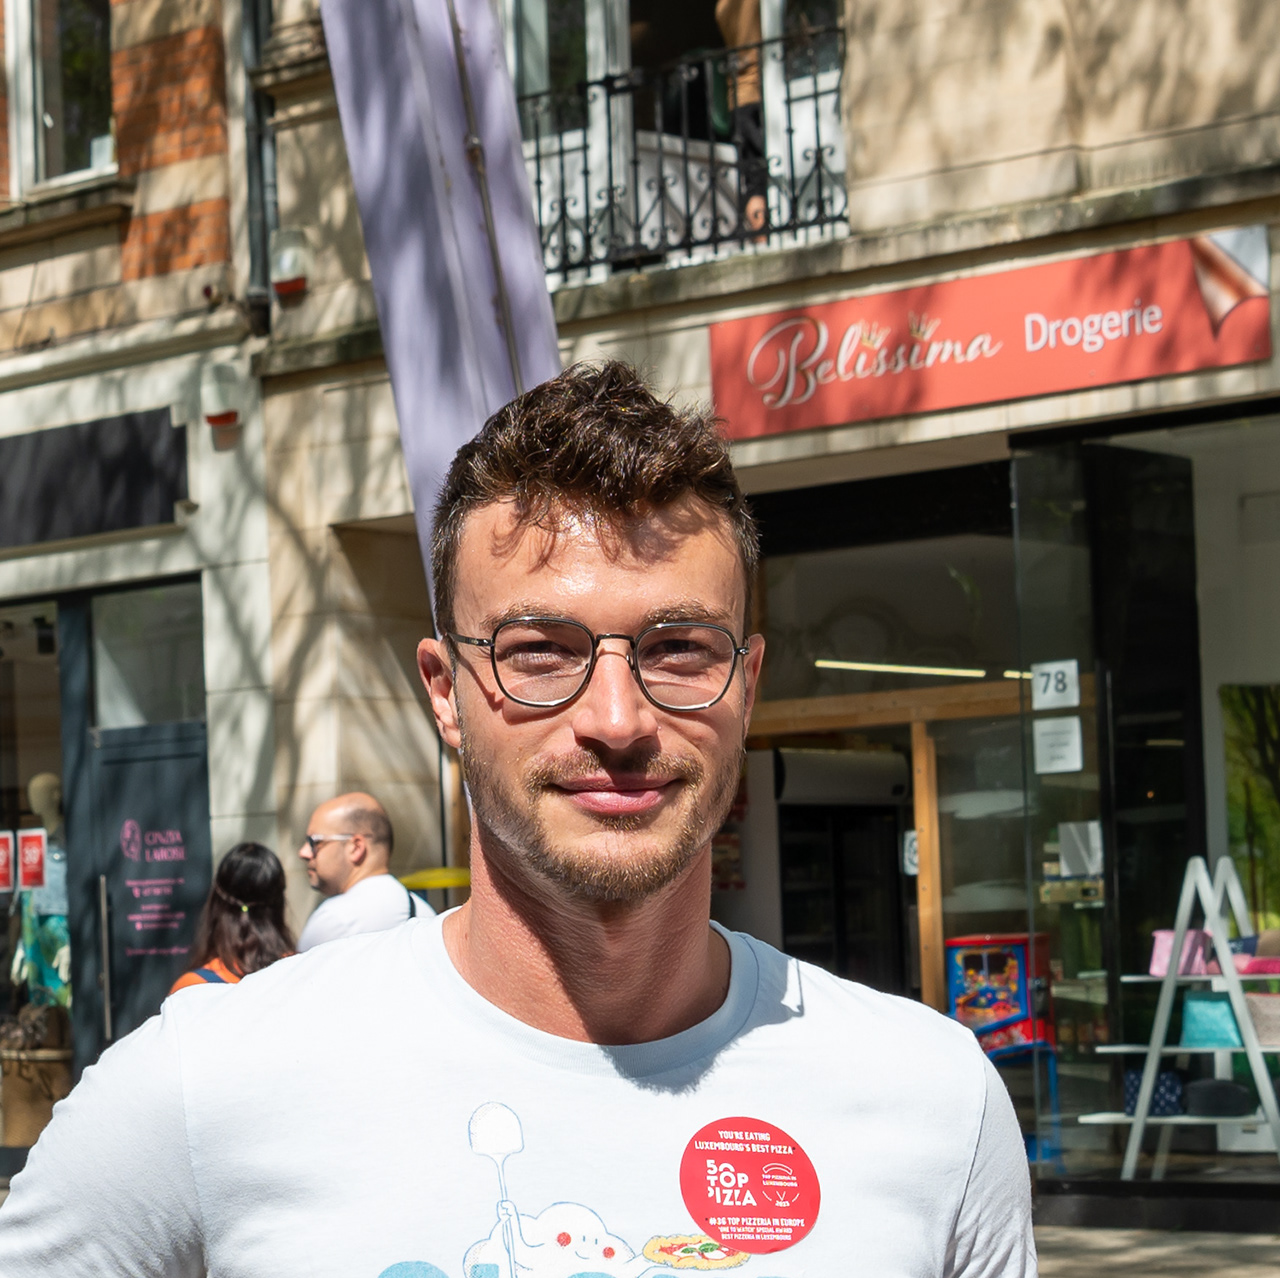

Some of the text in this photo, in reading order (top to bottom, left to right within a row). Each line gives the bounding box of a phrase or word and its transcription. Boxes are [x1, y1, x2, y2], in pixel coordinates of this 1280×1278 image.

[747, 299, 1163, 410] Belissima Drogerie
[1039, 670, 1067, 694] 78
[718, 1130, 771, 1141] YOU'RE EATING
[694, 1140, 751, 1152] LUXEMBOURG'S
[751, 1143, 770, 1153] BEST
[706, 1171, 749, 1188] TOP
[727, 1217, 741, 1226] TOP
[741, 1217, 772, 1226] PIZZERIA
[772, 1218, 780, 1226] IN
[780, 1218, 805, 1227] EUROPE
